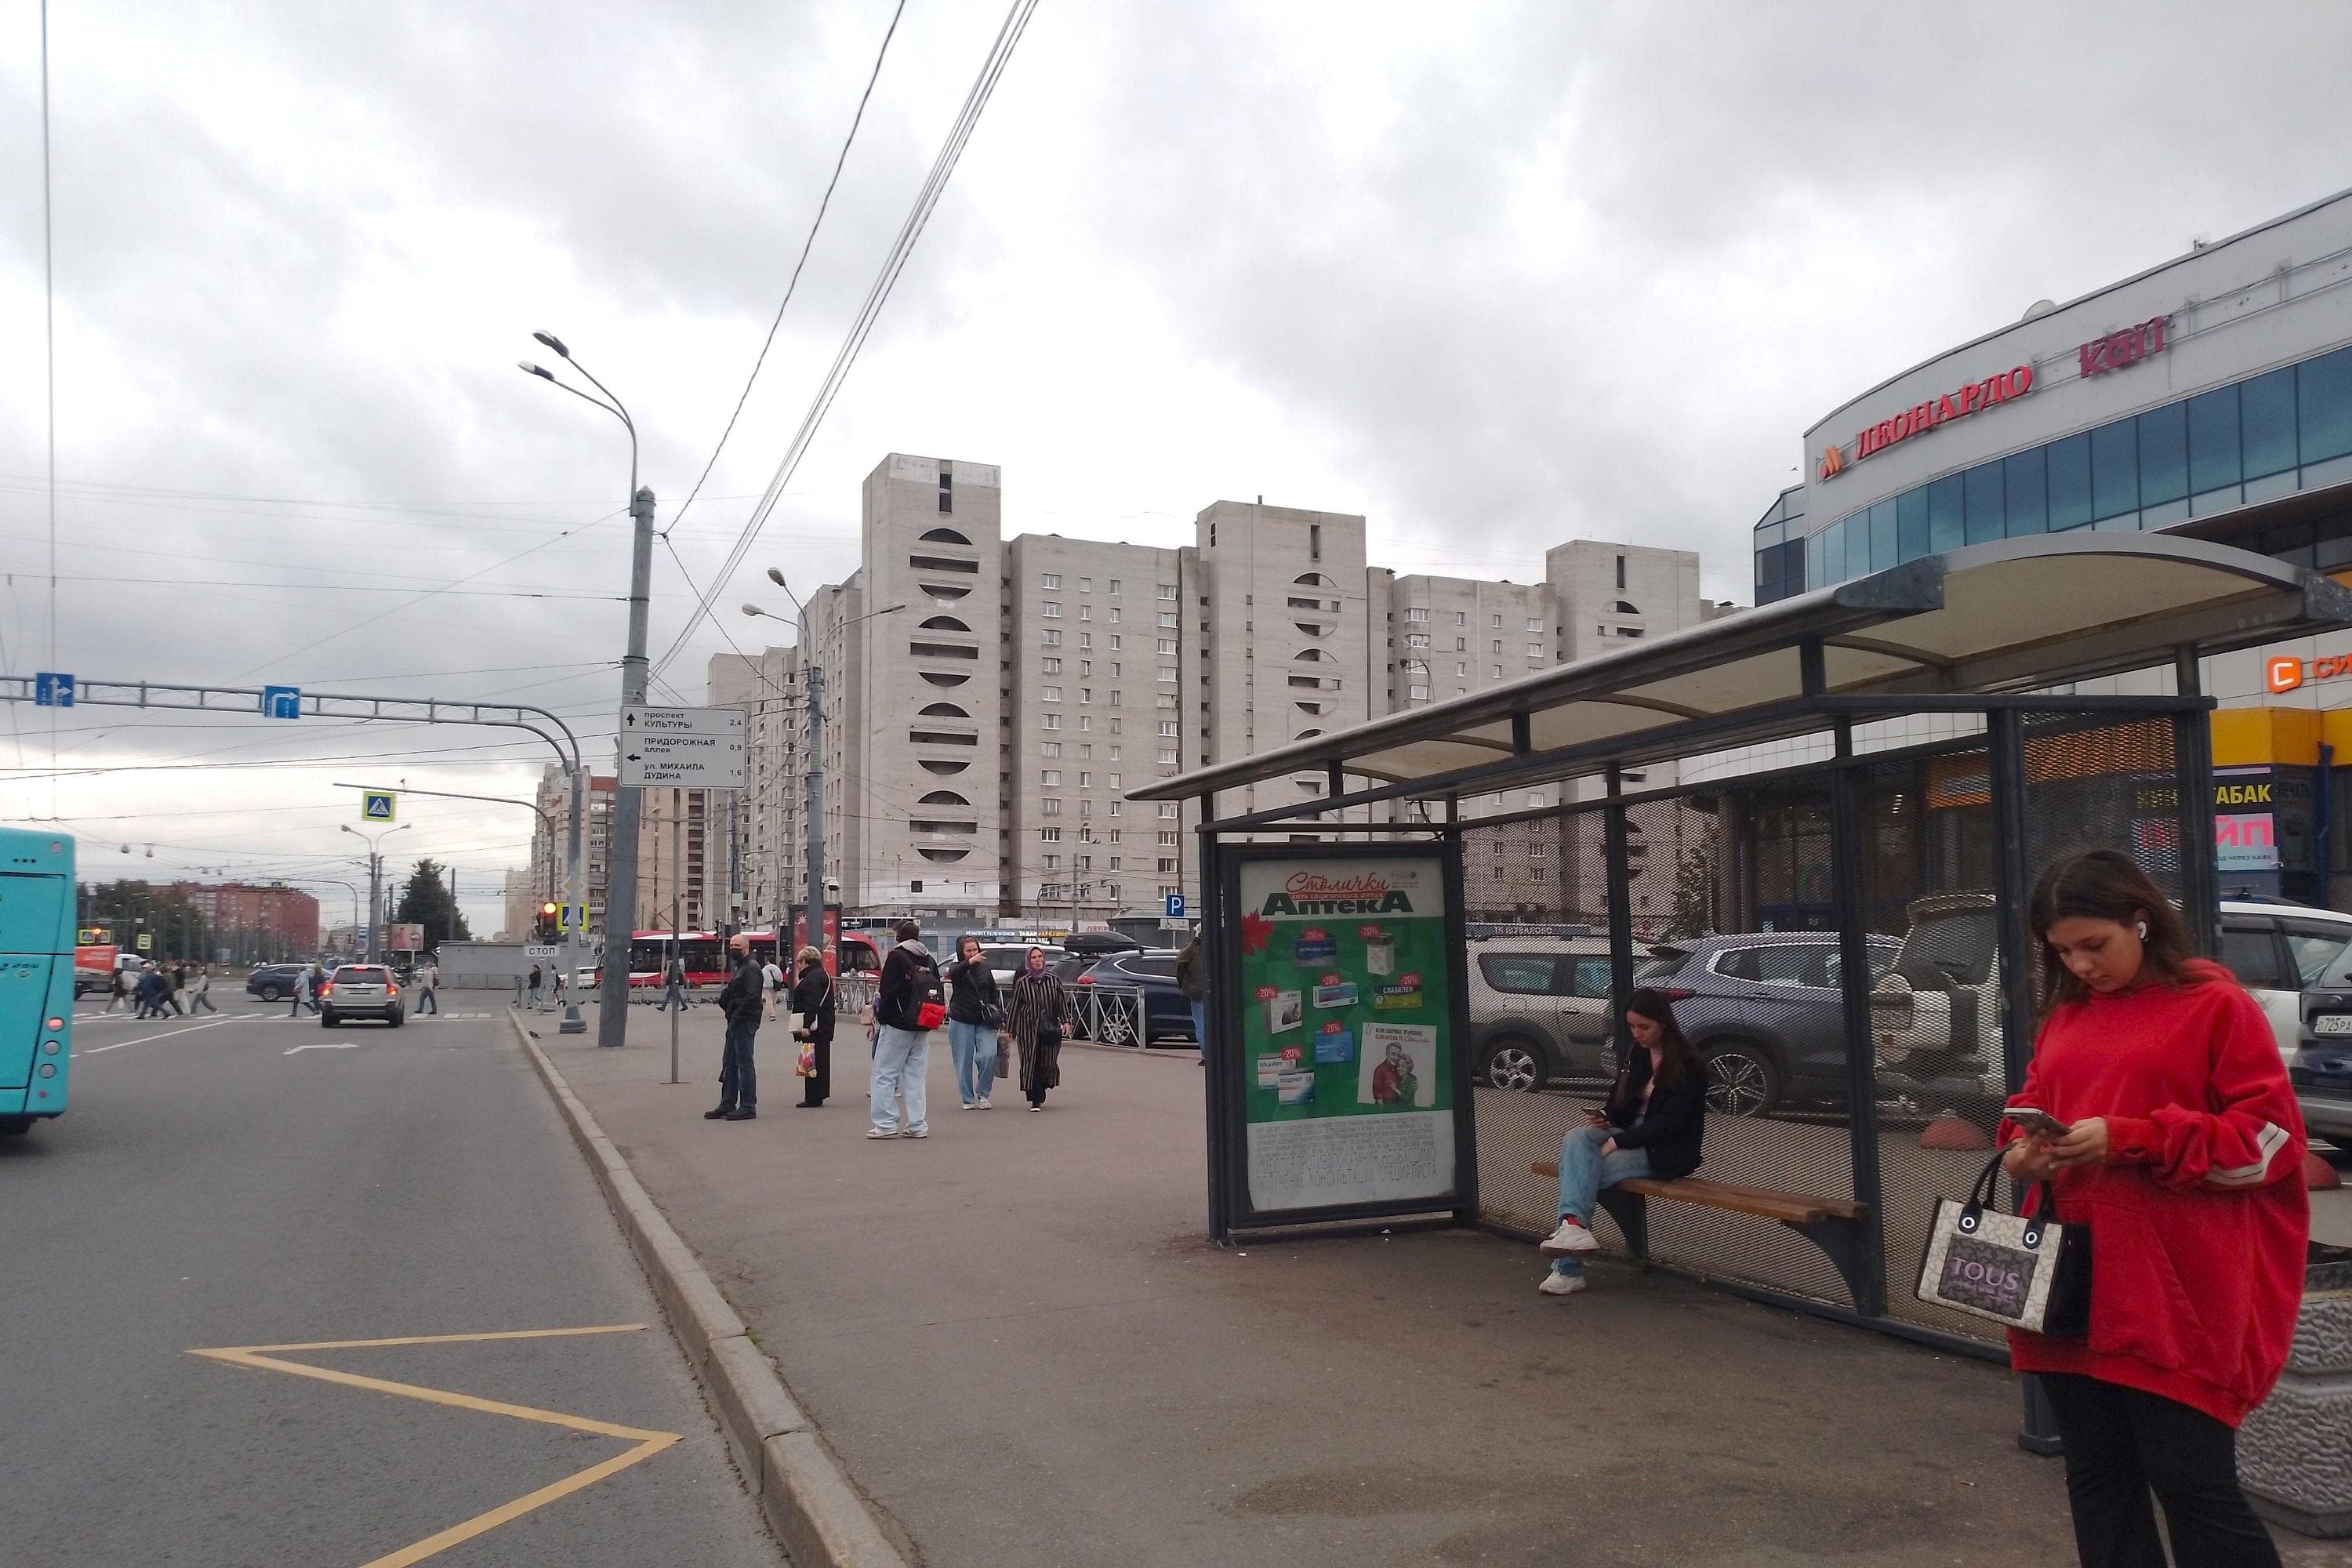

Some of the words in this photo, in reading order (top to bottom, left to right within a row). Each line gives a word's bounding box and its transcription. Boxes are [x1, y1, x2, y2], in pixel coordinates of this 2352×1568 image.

[1855, 365, 2033, 460] ЛЕОНАРДО
[644, 738, 716, 746] ПРИДОРОЖНАЯ
[644, 771, 681, 780] ДУДИНА
[2214, 784, 2272, 805] АБАК
[1286, 871, 1390, 893] Столички
[1171, 896, 1181, 915] P
[1323, 975, 1339, 985] -20%
[1258, 987, 1276, 998] -20%
[1324, 1022, 1341, 1033] -20%
[1282, 1047, 1301, 1058] -20%
[1949, 1257, 2020, 1290] TOUS
